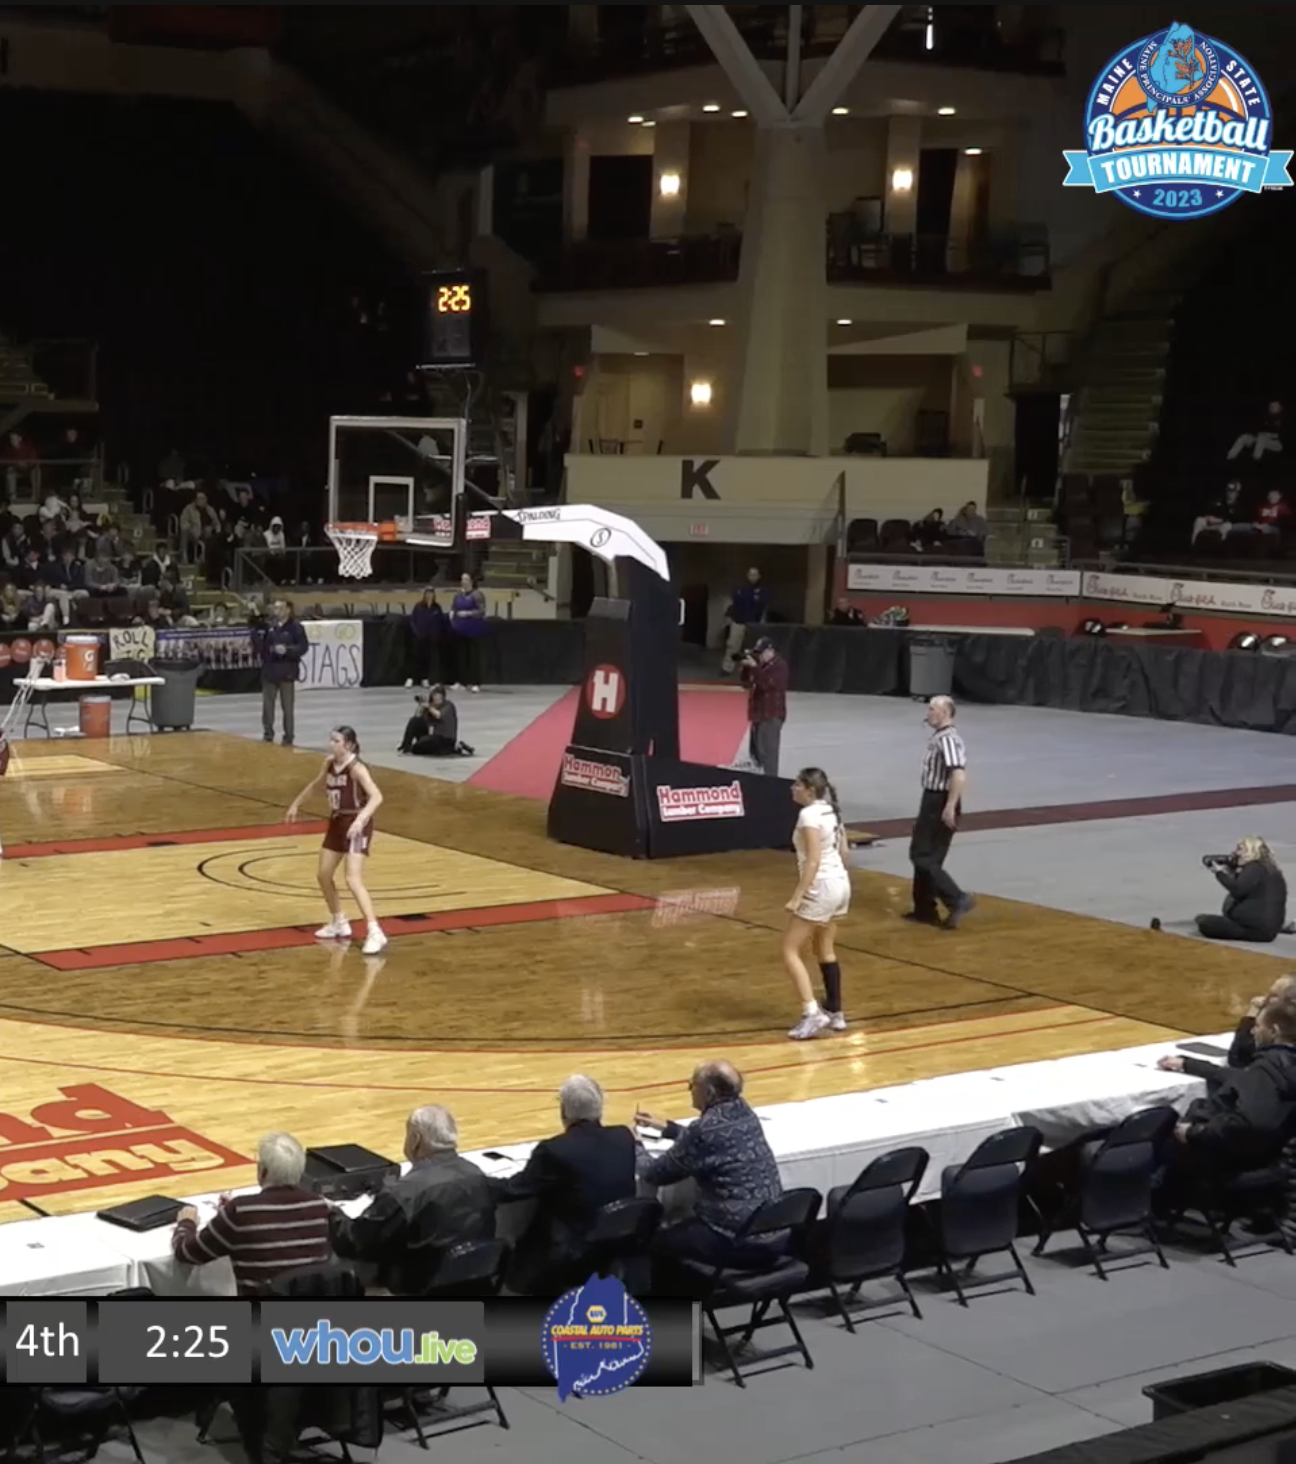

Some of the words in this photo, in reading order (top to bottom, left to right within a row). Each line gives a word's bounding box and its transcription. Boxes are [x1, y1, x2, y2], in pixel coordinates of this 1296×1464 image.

[438, 285, 471, 312] 2:25
[681, 459, 722, 500] K
[517, 507, 561, 523] SPALDING
[111, 630, 150, 649] ROLL
[592, 669, 619, 714] H
[659, 787, 740, 804] Hammond
